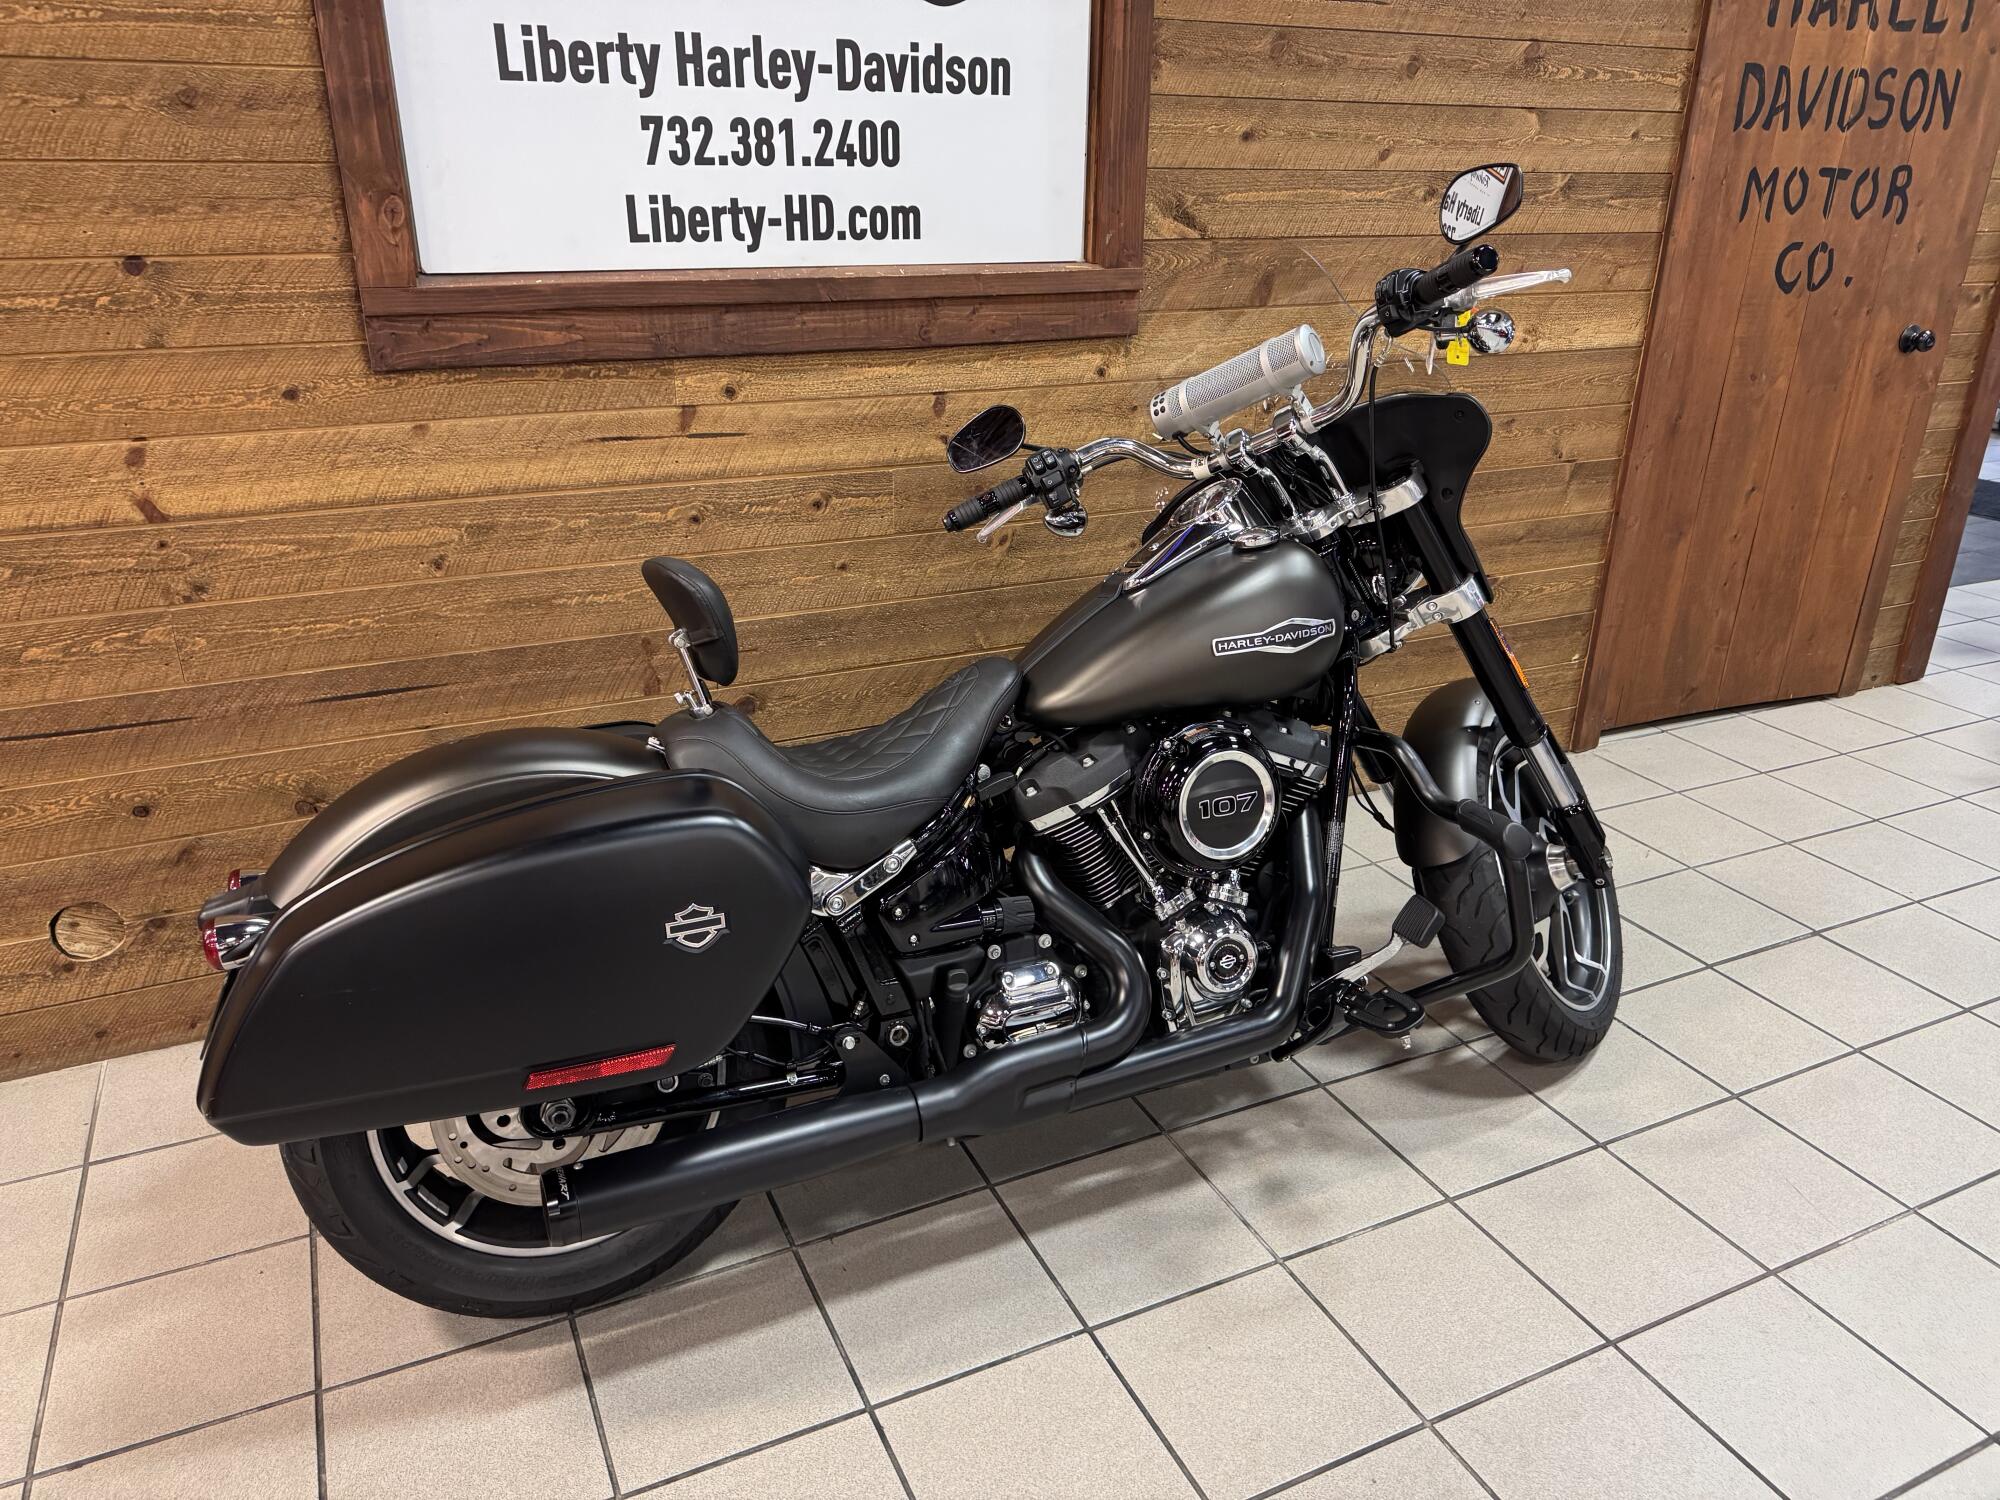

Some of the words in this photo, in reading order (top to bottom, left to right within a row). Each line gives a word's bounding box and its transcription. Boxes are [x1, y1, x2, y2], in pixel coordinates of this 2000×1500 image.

[493, 23, 661, 99] Liberty
[674, 31, 1011, 103] Harley-Davidson
[1733, 62, 1962, 133] DAVIDSON
[640, 115, 900, 168] 732.381.2400
[1739, 164, 1913, 225] MOTOR
[625, 194, 921, 253] Liberty-HD.com
[1775, 241, 1853, 294] CO.
[1218, 624, 1332, 651] HARLEY-DAVIDSON
[1199, 790, 1259, 819] 107
